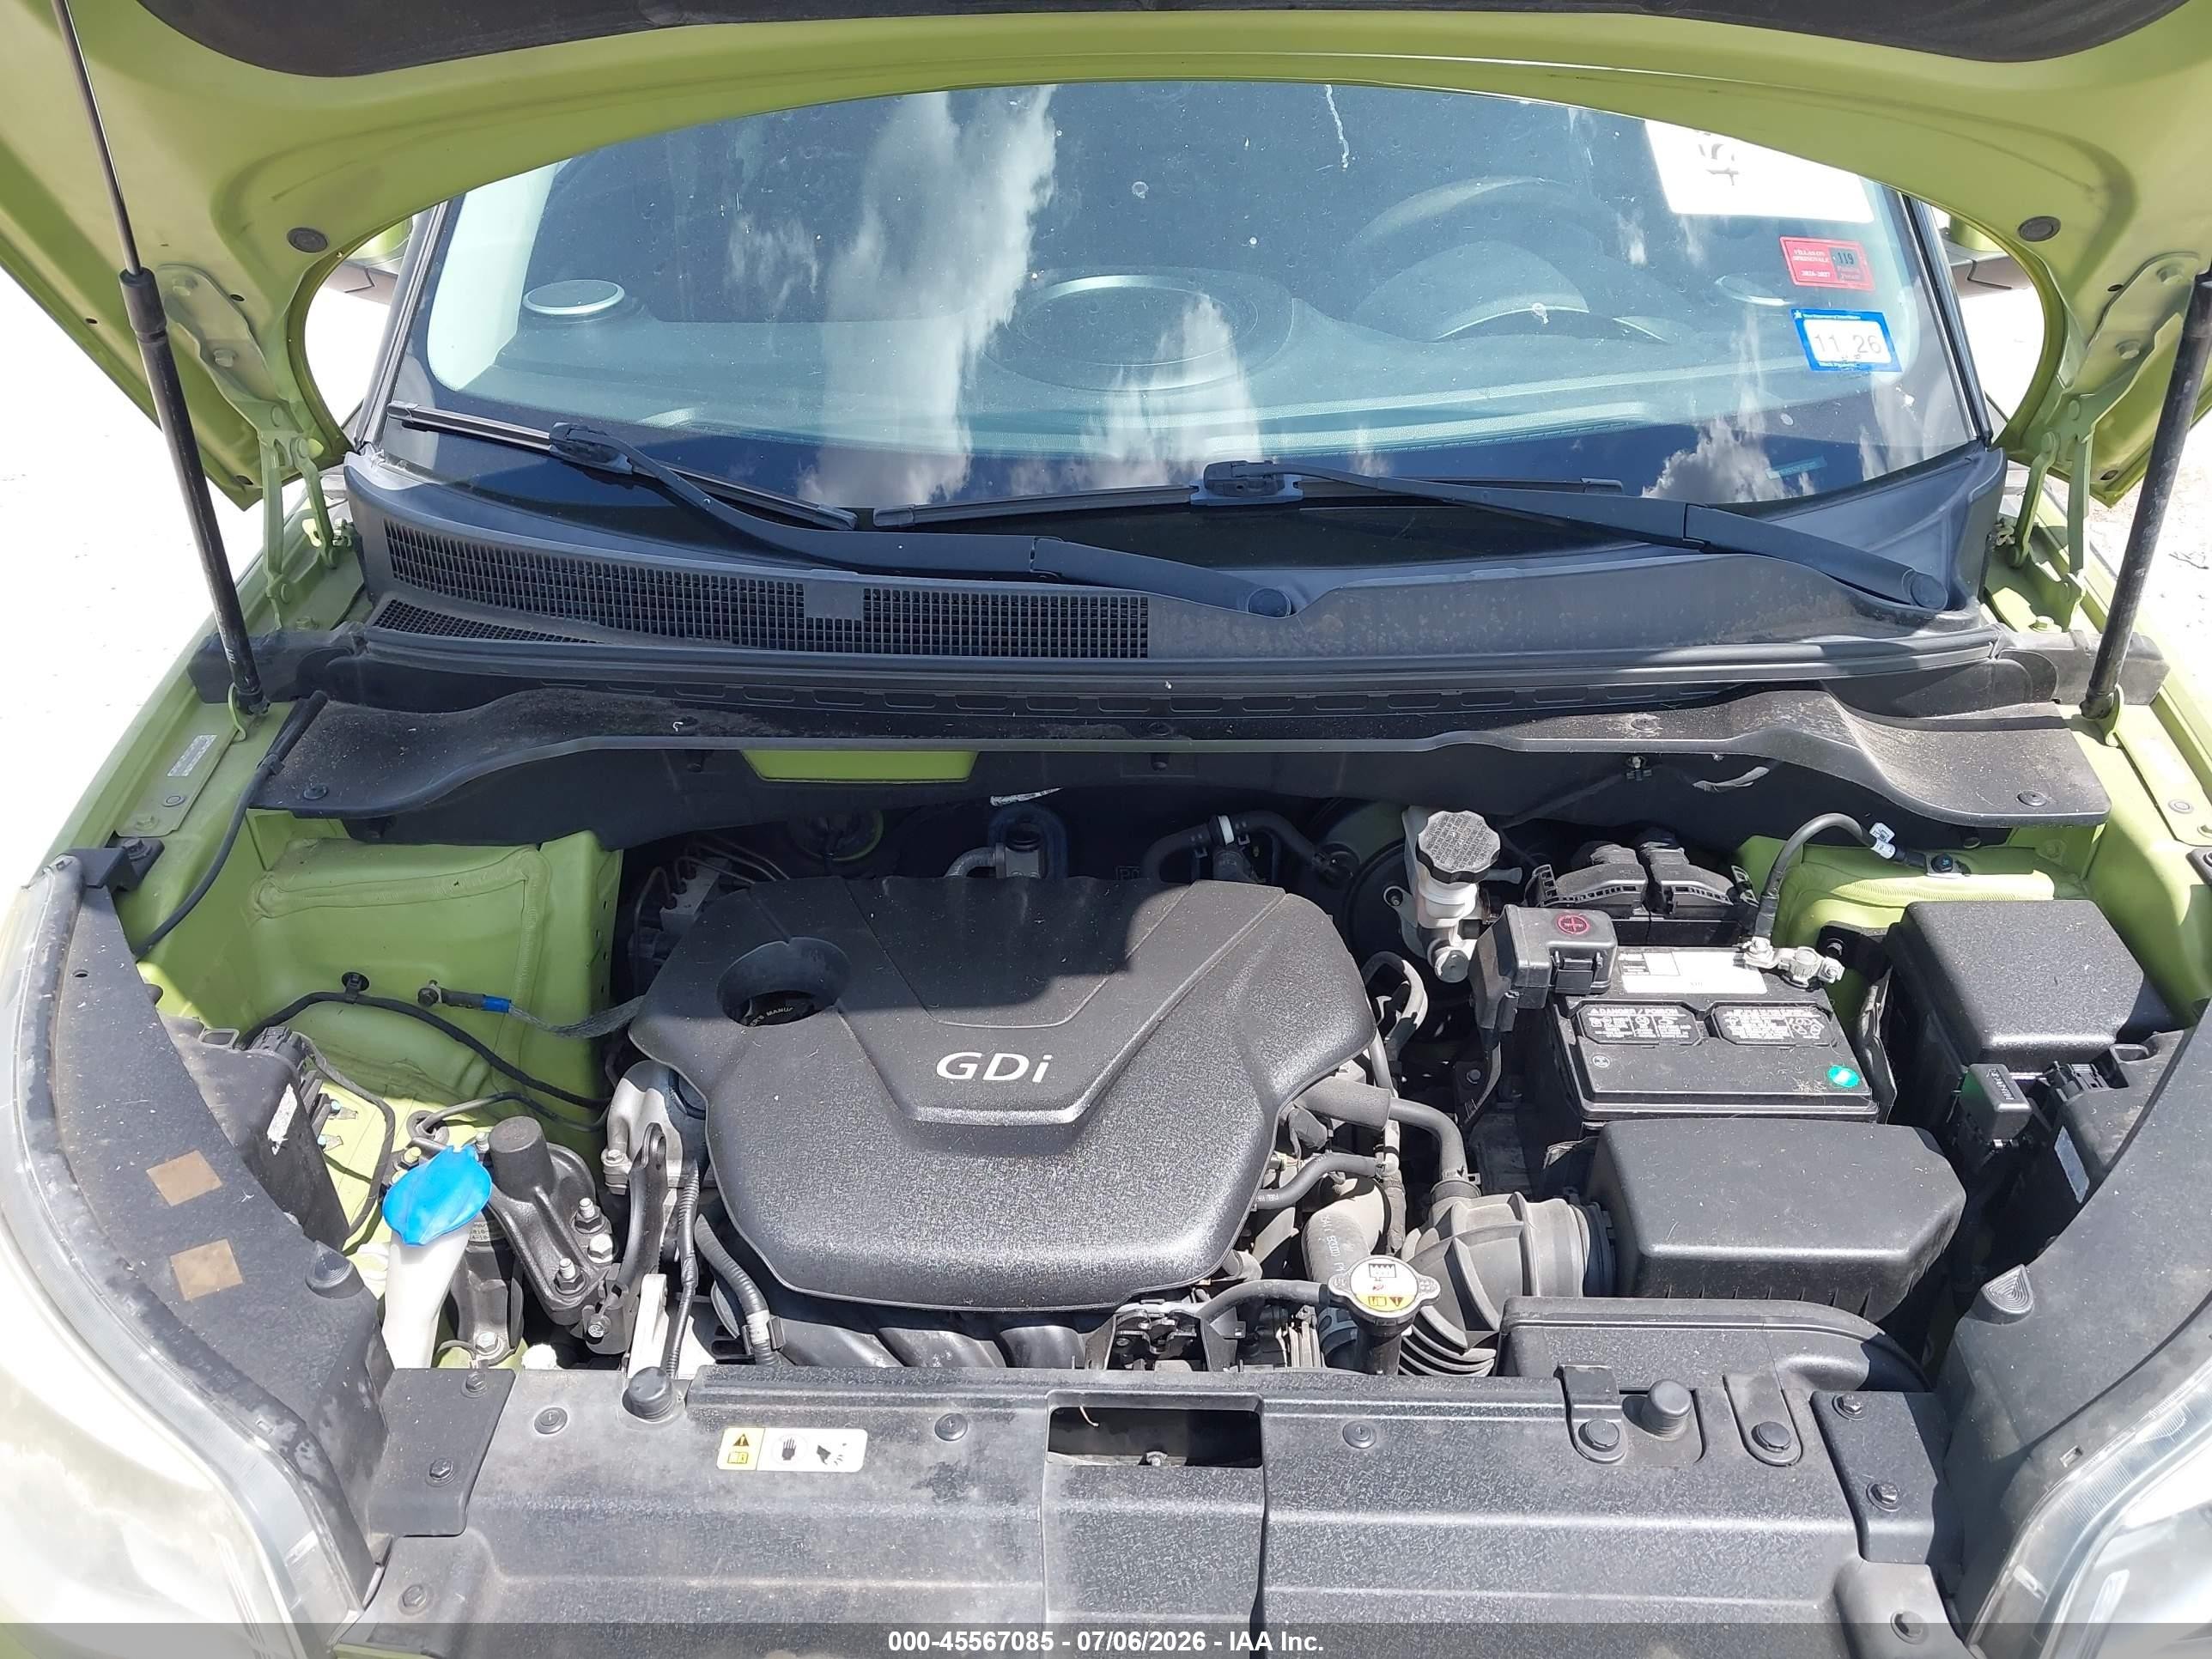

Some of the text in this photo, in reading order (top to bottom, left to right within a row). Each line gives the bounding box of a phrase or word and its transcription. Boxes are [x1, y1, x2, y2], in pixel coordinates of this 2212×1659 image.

[1838, 252, 1855, 264] 119
[1814, 333, 1881, 354] 11 26
[936, 1051, 1053, 1083] GDi
